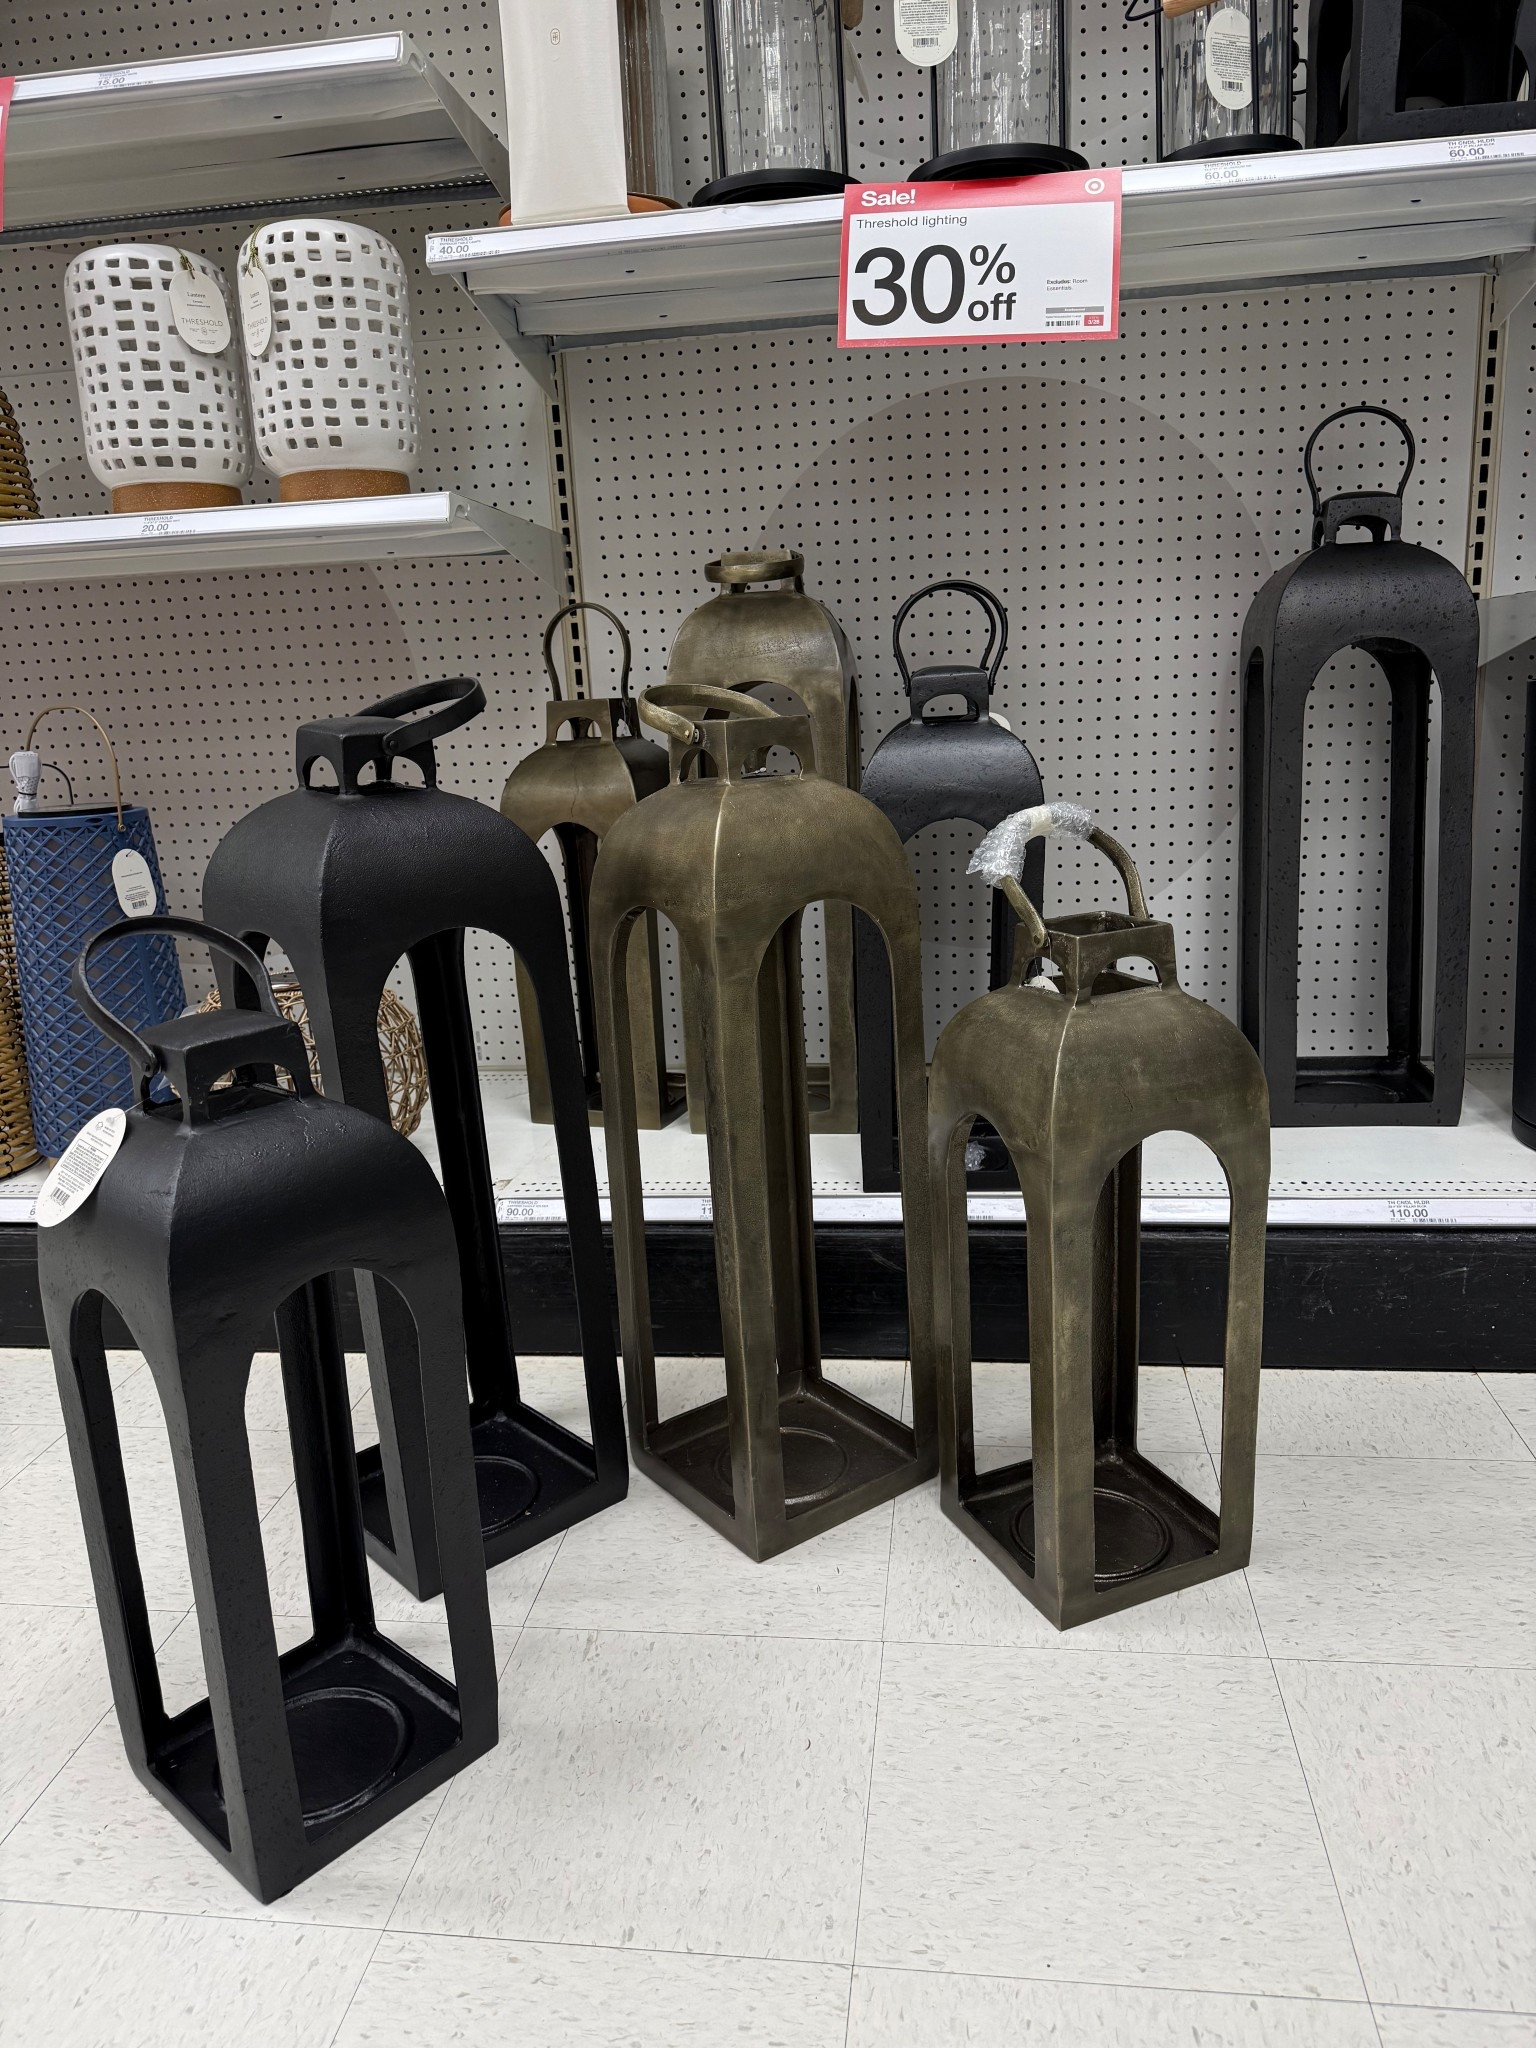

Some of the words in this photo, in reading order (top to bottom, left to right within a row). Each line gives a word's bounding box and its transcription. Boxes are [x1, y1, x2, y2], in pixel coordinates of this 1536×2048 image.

[98, 77, 125, 86] 15.00
[1449, 147, 1485, 158] 60.00
[1204, 169, 1239, 181] 60.00
[861, 189, 916, 207] Sale!
[856, 216, 918, 229] Threshold
[922, 215, 968, 228] lighting
[439, 244, 469, 254] 40.00
[967, 292, 1017, 322] off
[181, 317, 224, 327] THRESHOLD
[141, 523, 169, 533] 20.00
[506, 1208, 534, 1217] 90.00
[1389, 1208, 1429, 1218] 110.00
